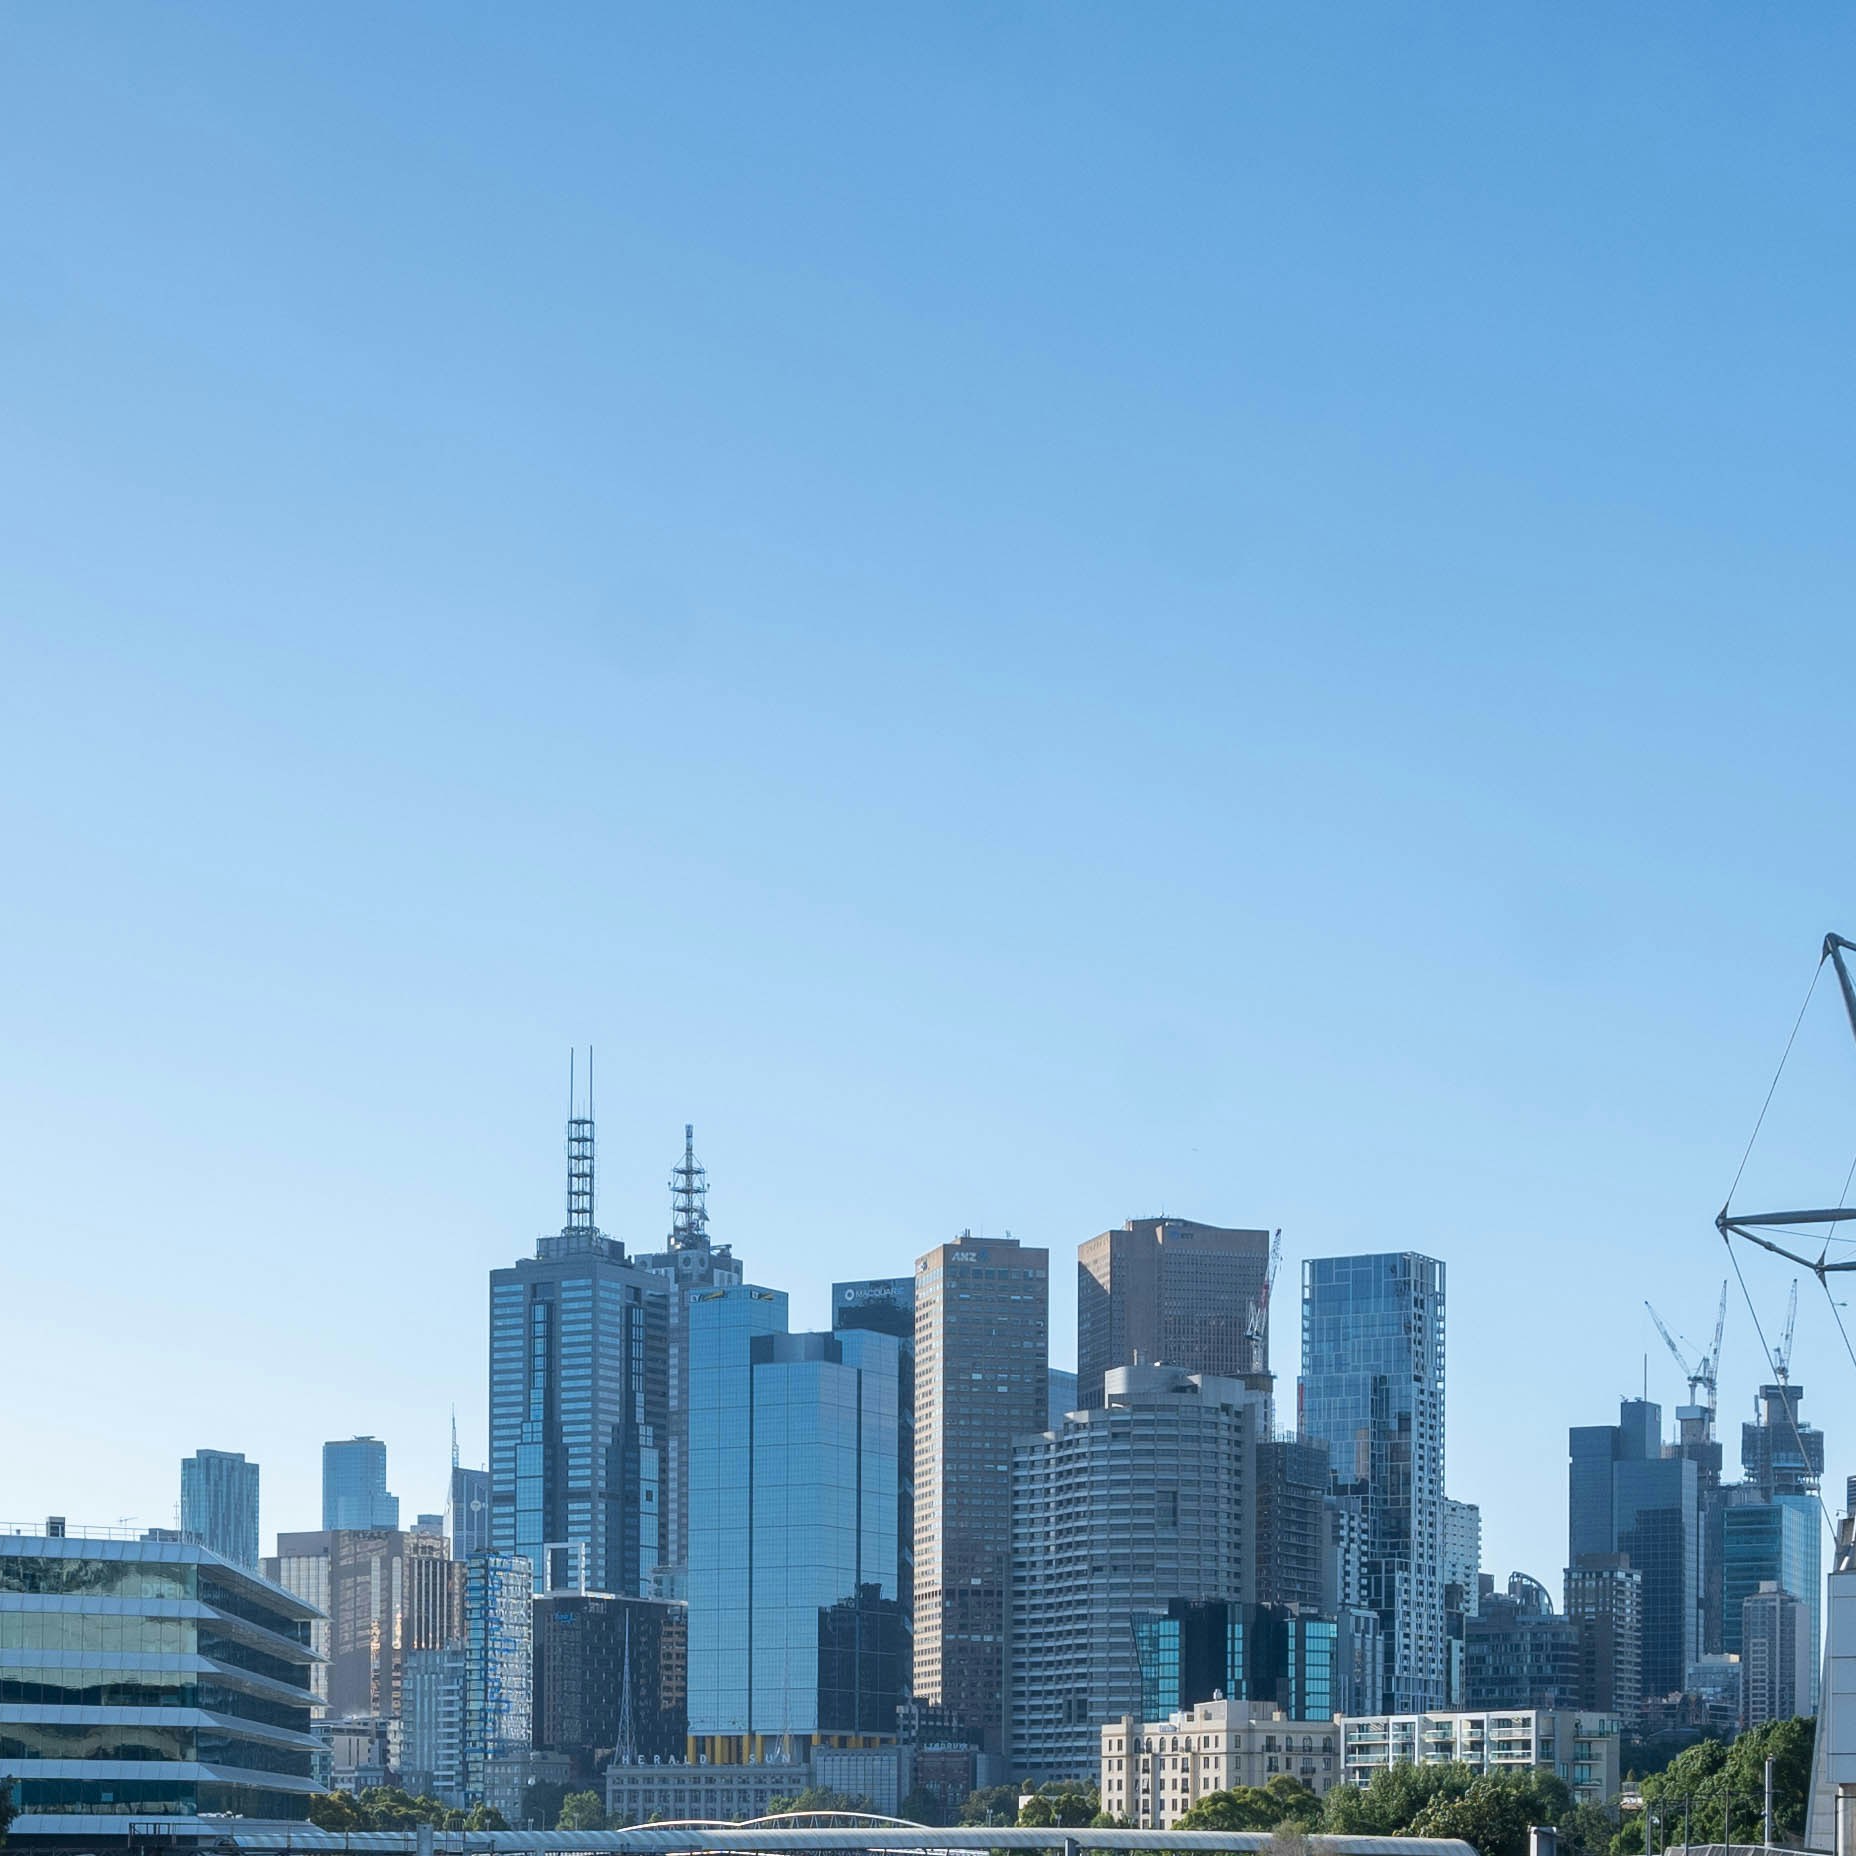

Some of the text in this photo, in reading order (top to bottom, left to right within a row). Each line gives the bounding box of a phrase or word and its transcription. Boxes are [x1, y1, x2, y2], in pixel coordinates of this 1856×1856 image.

[952, 1251, 977, 1262] ANZ
[622, 1754, 792, 1765] HERALD SUN
